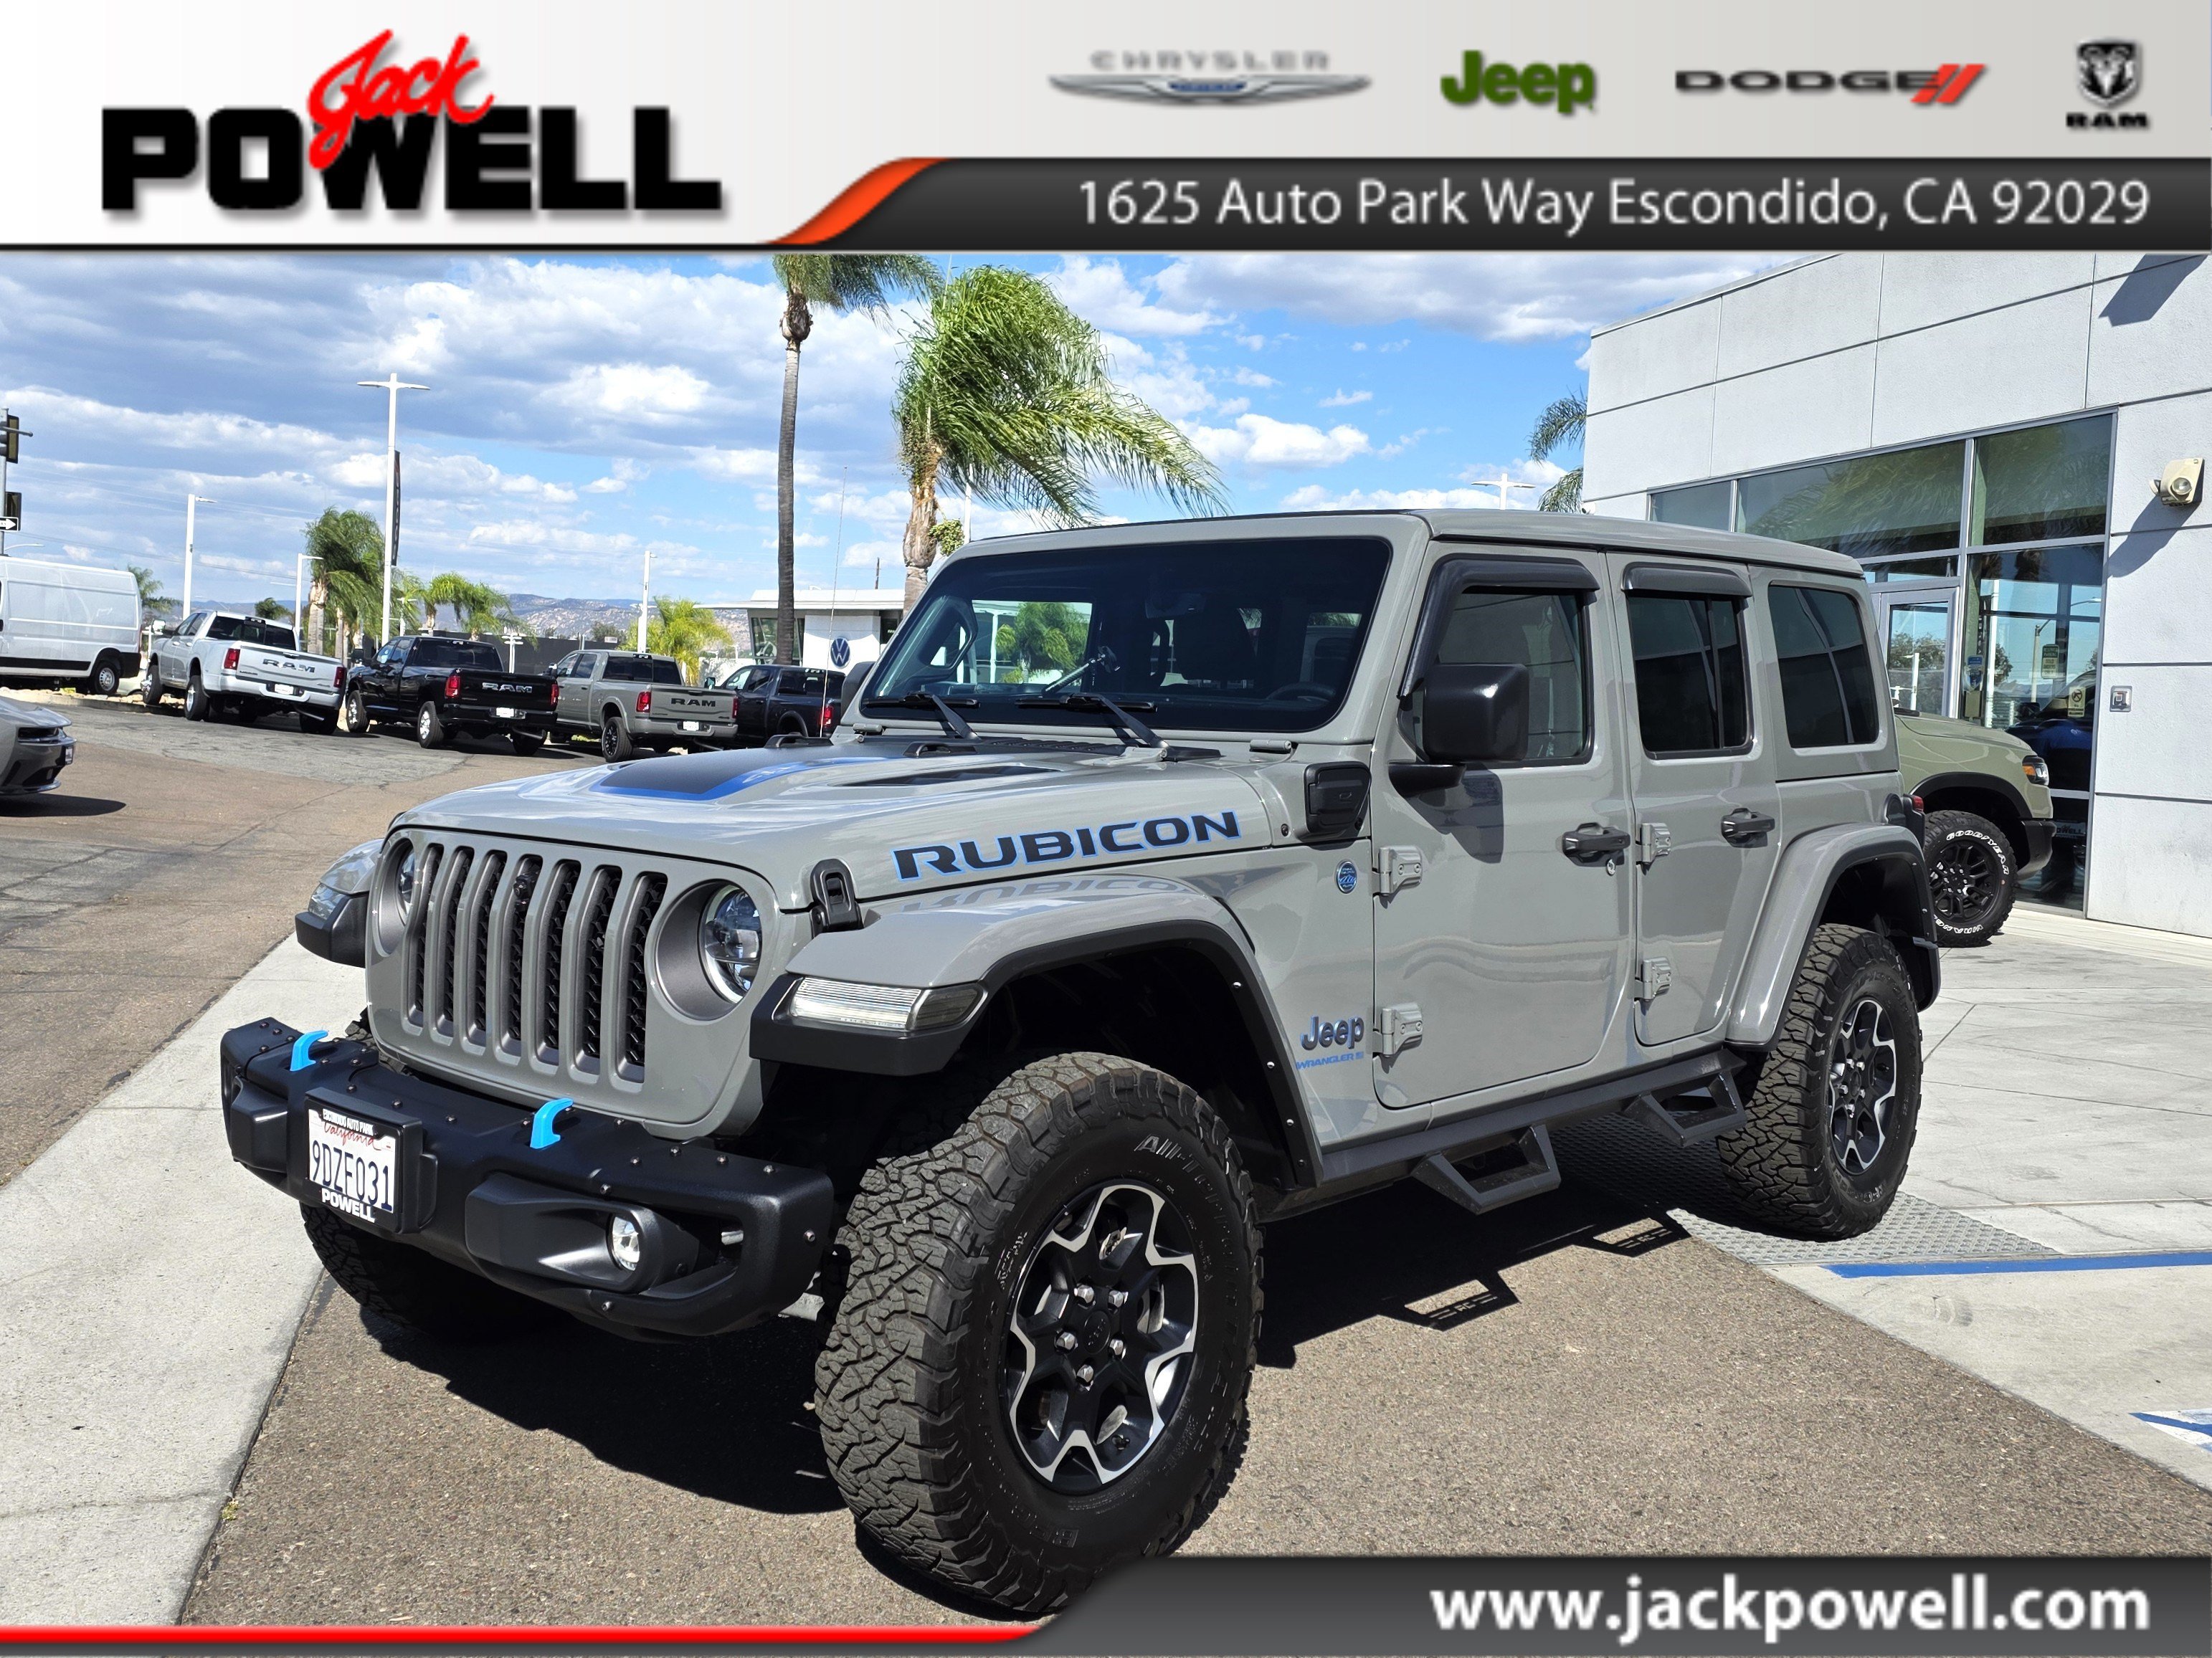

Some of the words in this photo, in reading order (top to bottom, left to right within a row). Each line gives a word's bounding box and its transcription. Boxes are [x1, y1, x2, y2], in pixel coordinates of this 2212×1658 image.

[262, 659, 315, 672] RAM
[482, 682, 532, 693] RAM
[671, 698, 716, 707] RAM
[891, 809, 1241, 882] RUBICON
[1934, 914, 1983, 934] WRANG
[1300, 1015, 1364, 1051] Jeep
[1296, 1053, 1354, 1069] WRANGLER
[321, 1187, 376, 1223] POWELL
